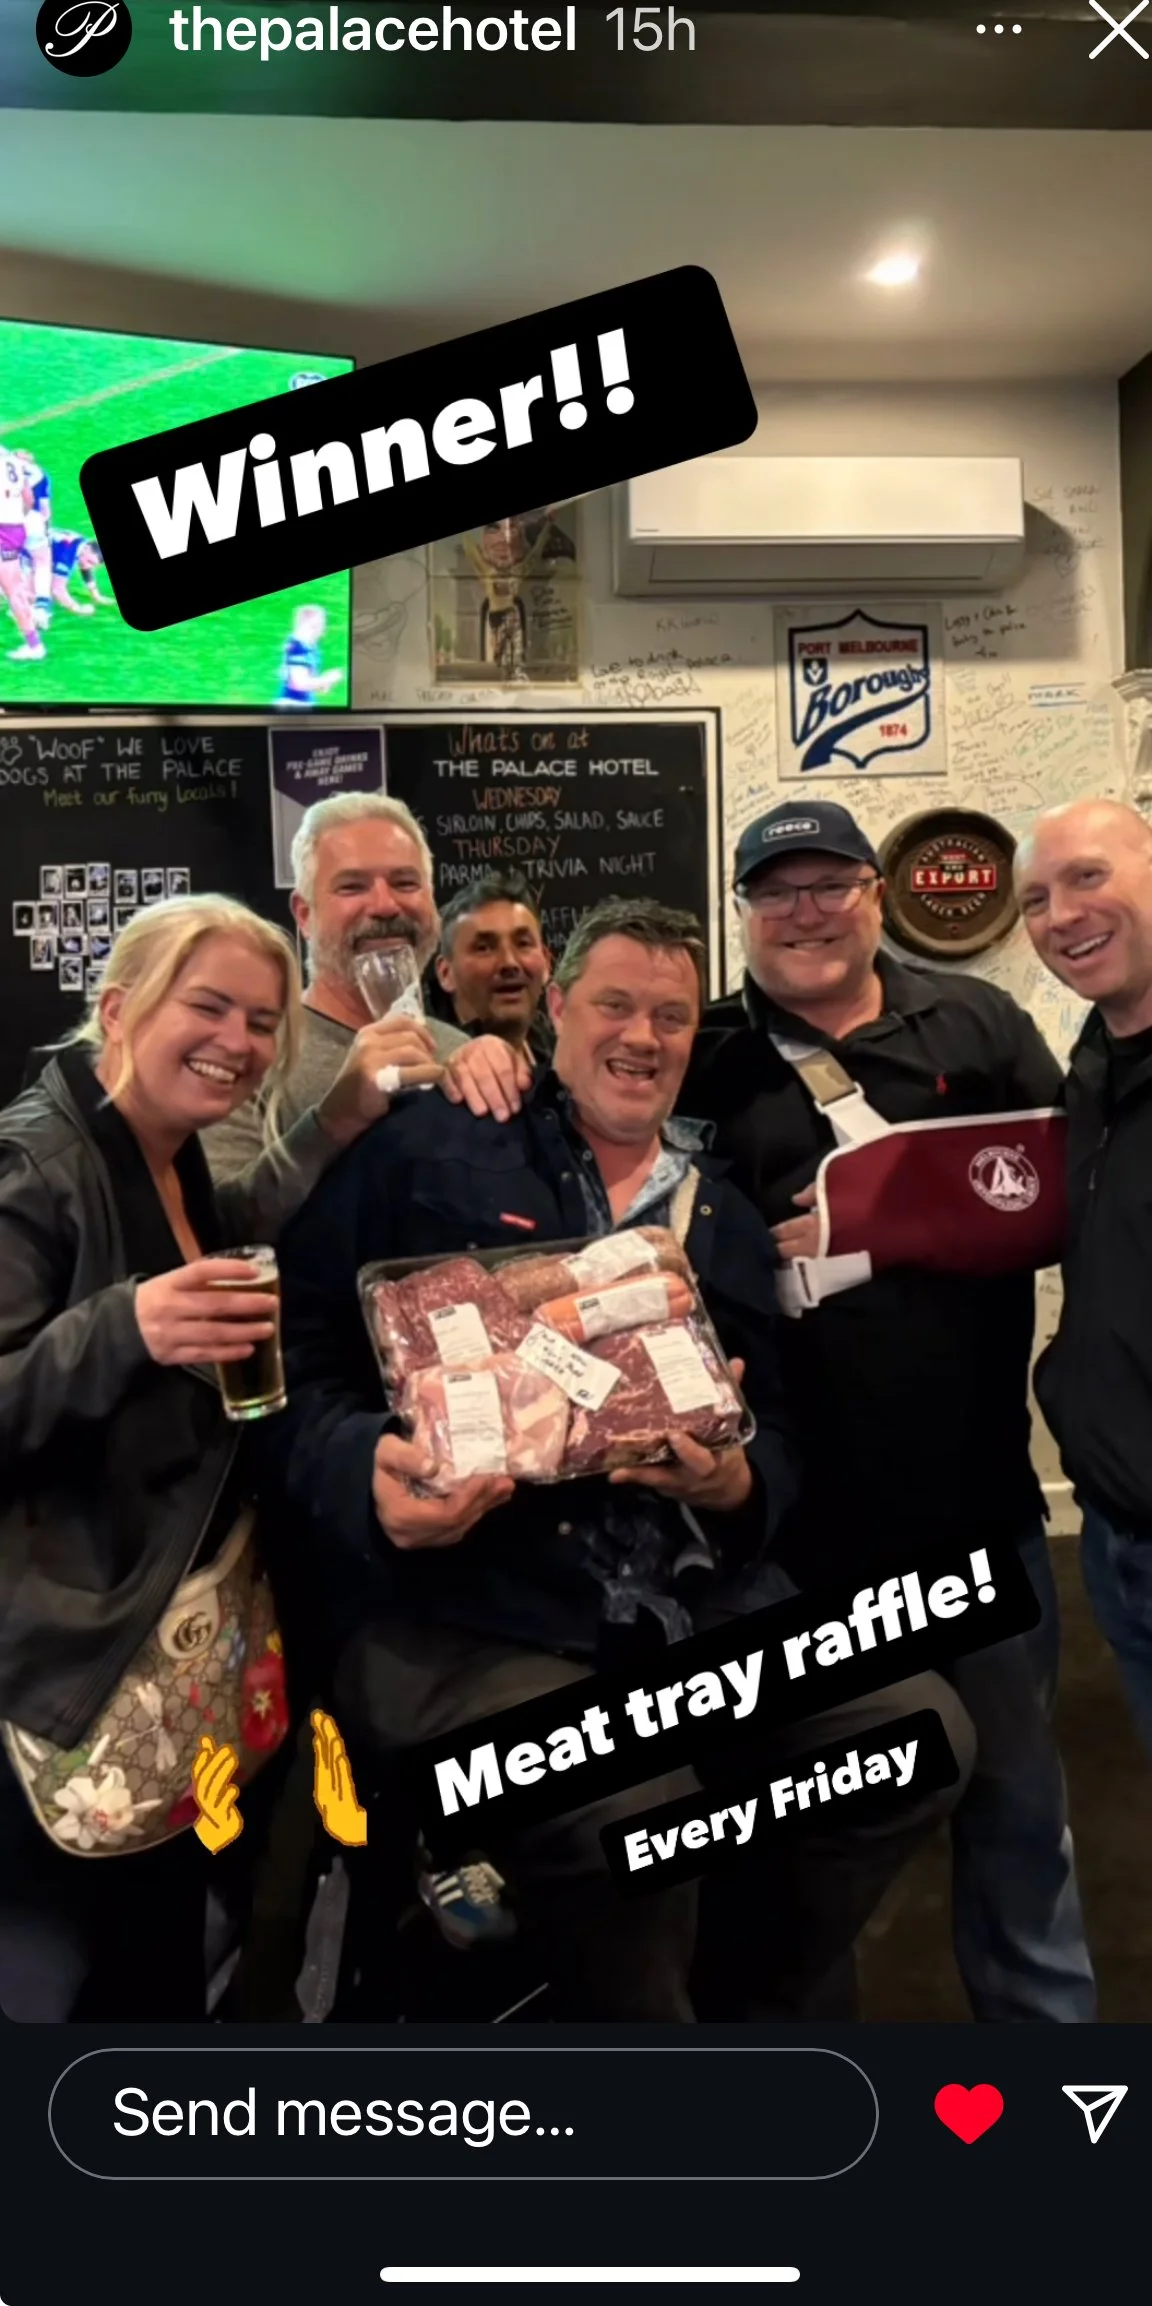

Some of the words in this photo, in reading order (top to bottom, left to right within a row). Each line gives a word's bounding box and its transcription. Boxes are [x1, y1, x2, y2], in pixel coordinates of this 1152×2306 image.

[798, 642, 832, 655] PORT
[838, 638, 919, 654] MELBOURNE
[797, 663, 931, 747] Boroughs
[530, 731, 556, 752] on
[567, 726, 590, 750] at
[879, 723, 908, 739] 1874
[117, 737, 143, 756] WE
[161, 736, 215, 756] LOVE
[63, 764, 87, 783] AT
[100, 762, 141, 780] THE
[163, 758, 243, 780] PALACE
[433, 759, 479, 777] THE
[491, 759, 577, 777] PALACE
[588, 758, 660, 777] HOTEL
[43, 789, 83, 807] Meet
[93, 790, 120, 806] our
[472, 786, 562, 811] WEDNESDAY
[616, 808, 665, 830] SAUCE
[768, 822, 811, 836] reece
[452, 834, 562, 860] THURSDAY
[921, 838, 985, 864] AUSTRALIAN
[522, 856, 589, 880] TRIVIA
[599, 852, 656, 876] NIGHT
[915, 869, 993, 886] EXPORT
